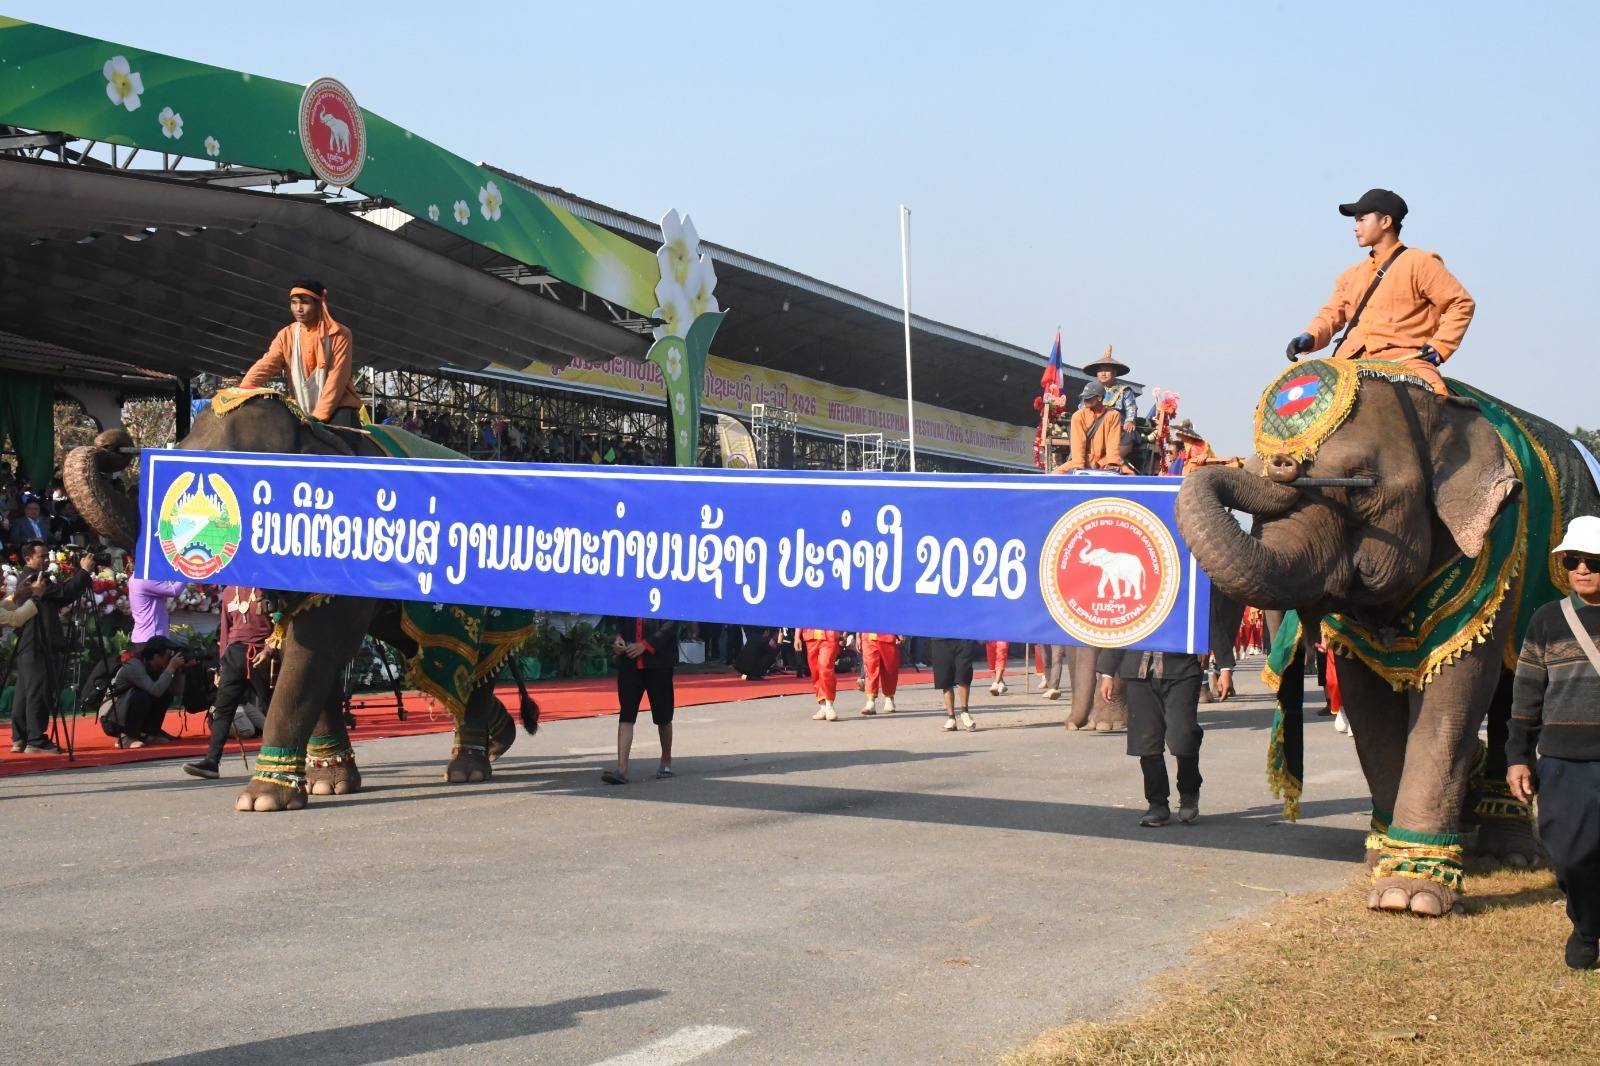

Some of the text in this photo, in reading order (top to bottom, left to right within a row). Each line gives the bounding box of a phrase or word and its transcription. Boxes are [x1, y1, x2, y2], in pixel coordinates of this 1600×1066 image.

[792, 393, 817, 416] 2026
[828, 400, 867, 425] WELCOME
[868, 409, 878, 427] TO
[879, 412, 911, 433] ELEPHAN
[1116, 521, 1130, 529] LAO
[1129, 526, 1143, 537] PDR
[250, 479, 1027, 613] ຍິນດີຕ້ອນຮັບສູ່ ງານມະຫະກຳບຸນຊ້າງ ປະຈຳປີ 2026
[1068, 598, 1147, 625] ELEPHANT FESTIVAL
